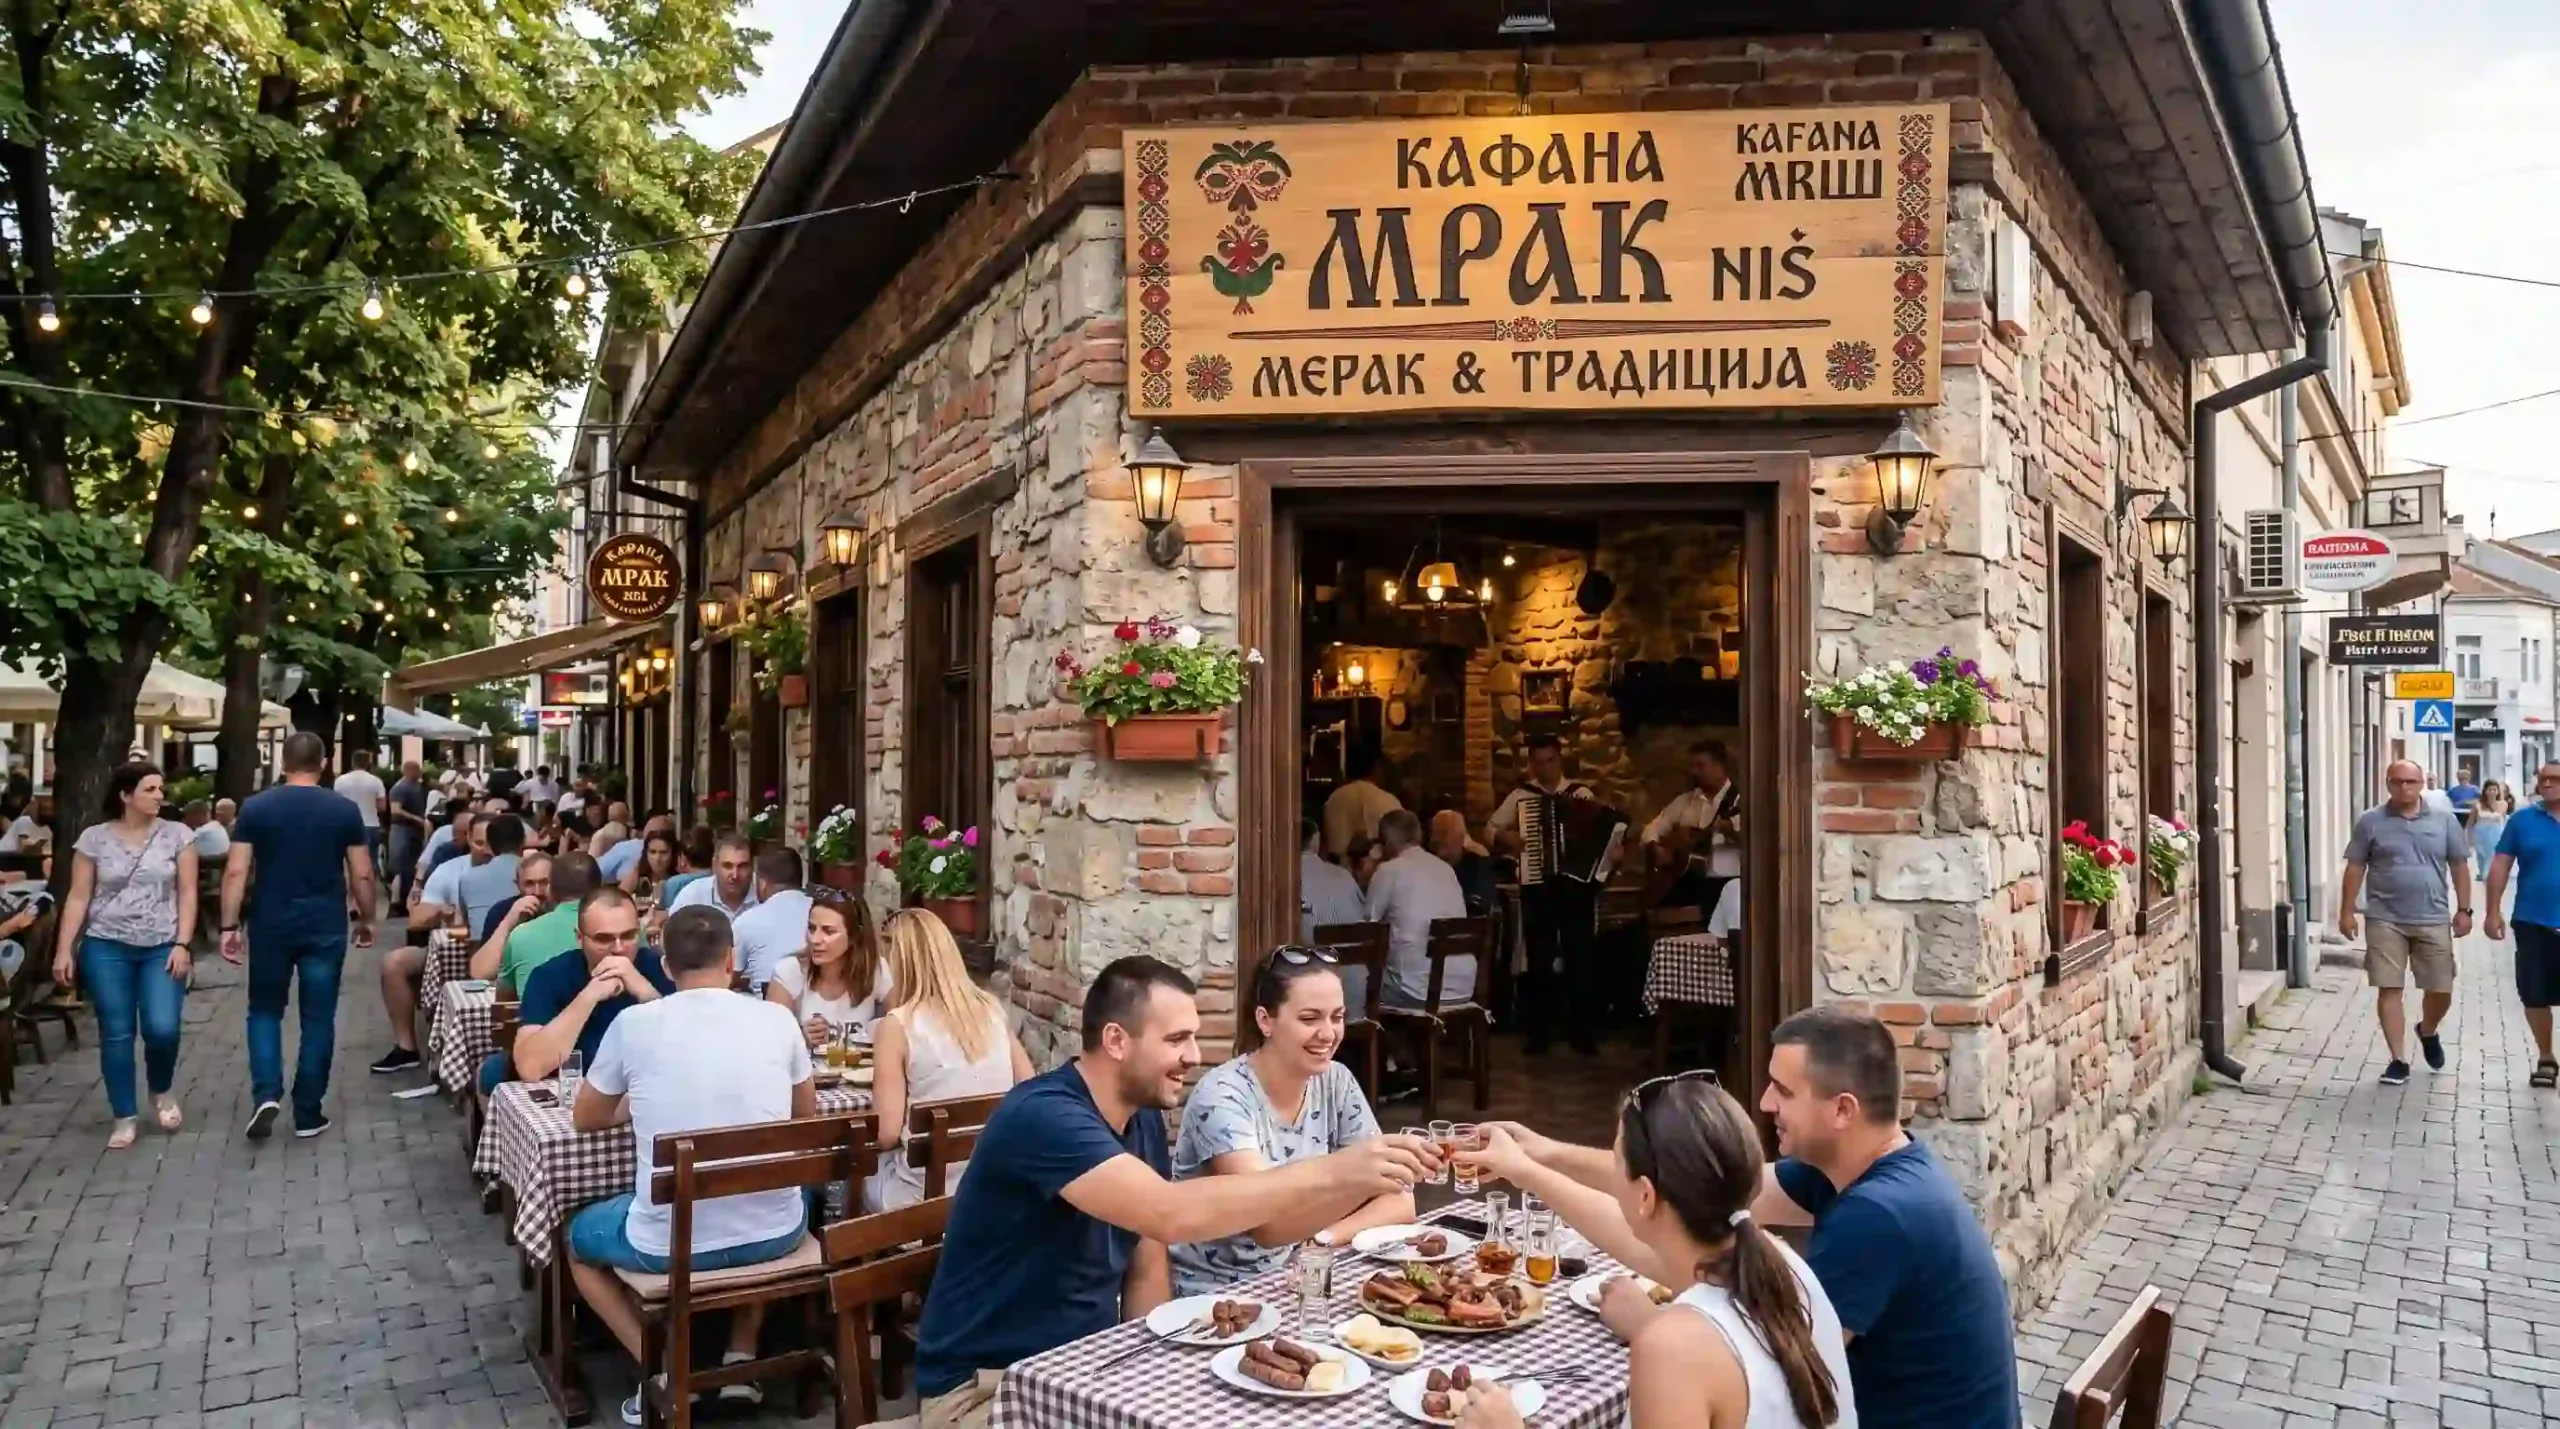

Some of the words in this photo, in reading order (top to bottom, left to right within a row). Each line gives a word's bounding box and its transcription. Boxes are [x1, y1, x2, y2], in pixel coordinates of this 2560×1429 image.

[1398, 131, 1664, 188] КАФАНА
[1737, 120, 1881, 154] KAFANA
[1308, 199, 1673, 309] МРАК
[1712, 226, 1816, 301] NIŠ
[1452, 351, 1487, 394] &
[1511, 345, 1808, 399] ТРАДИЦИЈА
[601, 568, 669, 587] МРАК
